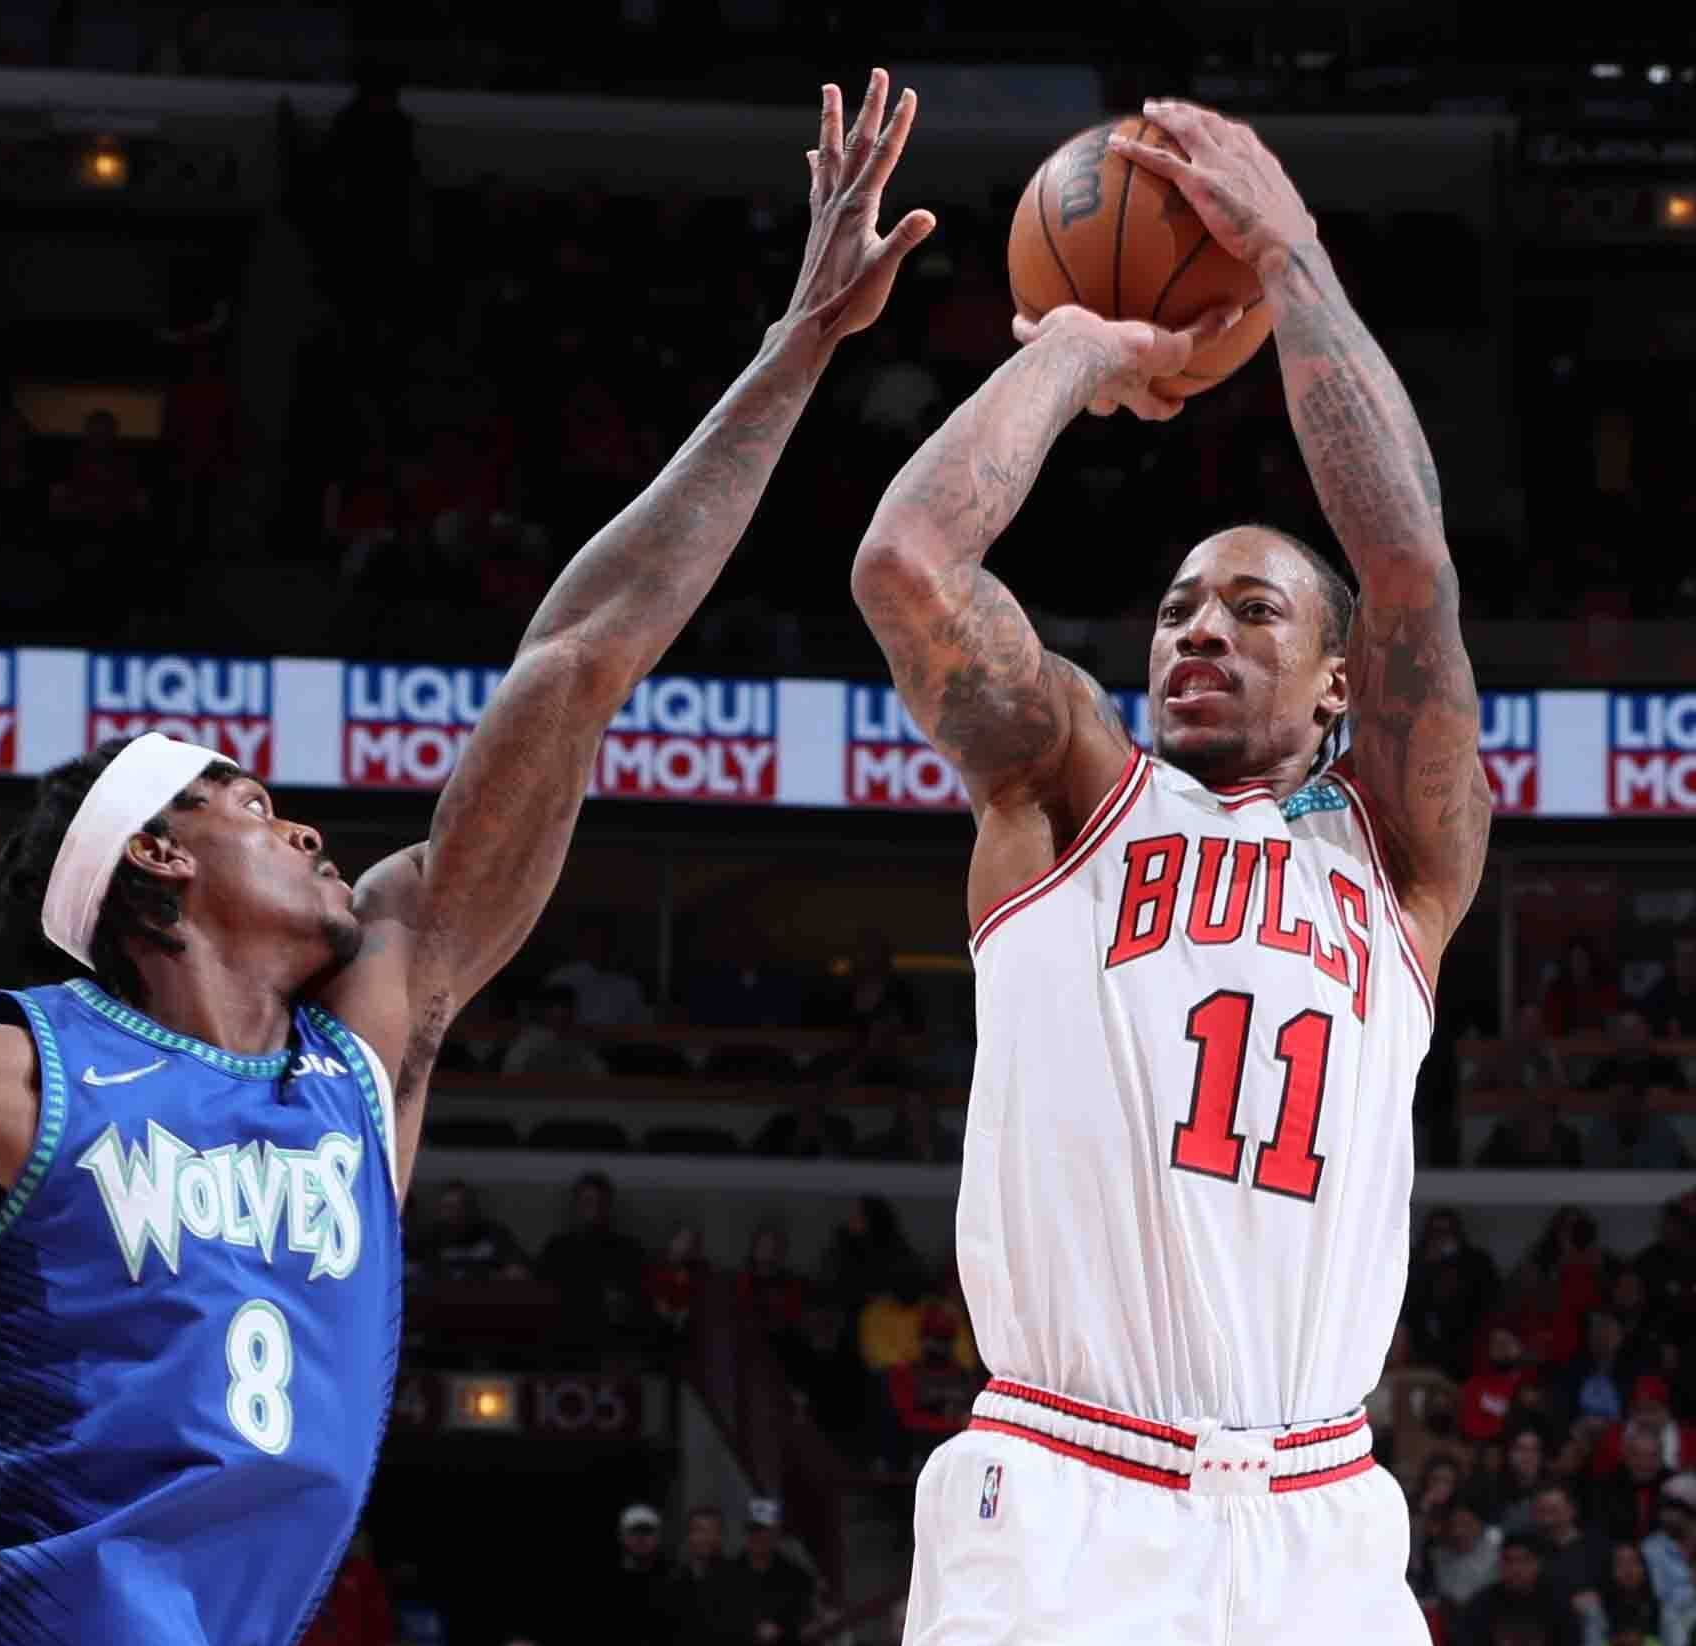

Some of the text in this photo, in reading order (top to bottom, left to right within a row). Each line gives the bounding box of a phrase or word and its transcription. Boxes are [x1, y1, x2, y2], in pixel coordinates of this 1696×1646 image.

[96, 655, 266, 715] LIQUI
[348, 664, 501, 722] LIQU
[604, 738, 775, 796] MOLY
[1170, 988, 1334, 1204] 11
[76, 1119, 362, 1283] WOLVES
[225, 1298, 294, 1456] 8
